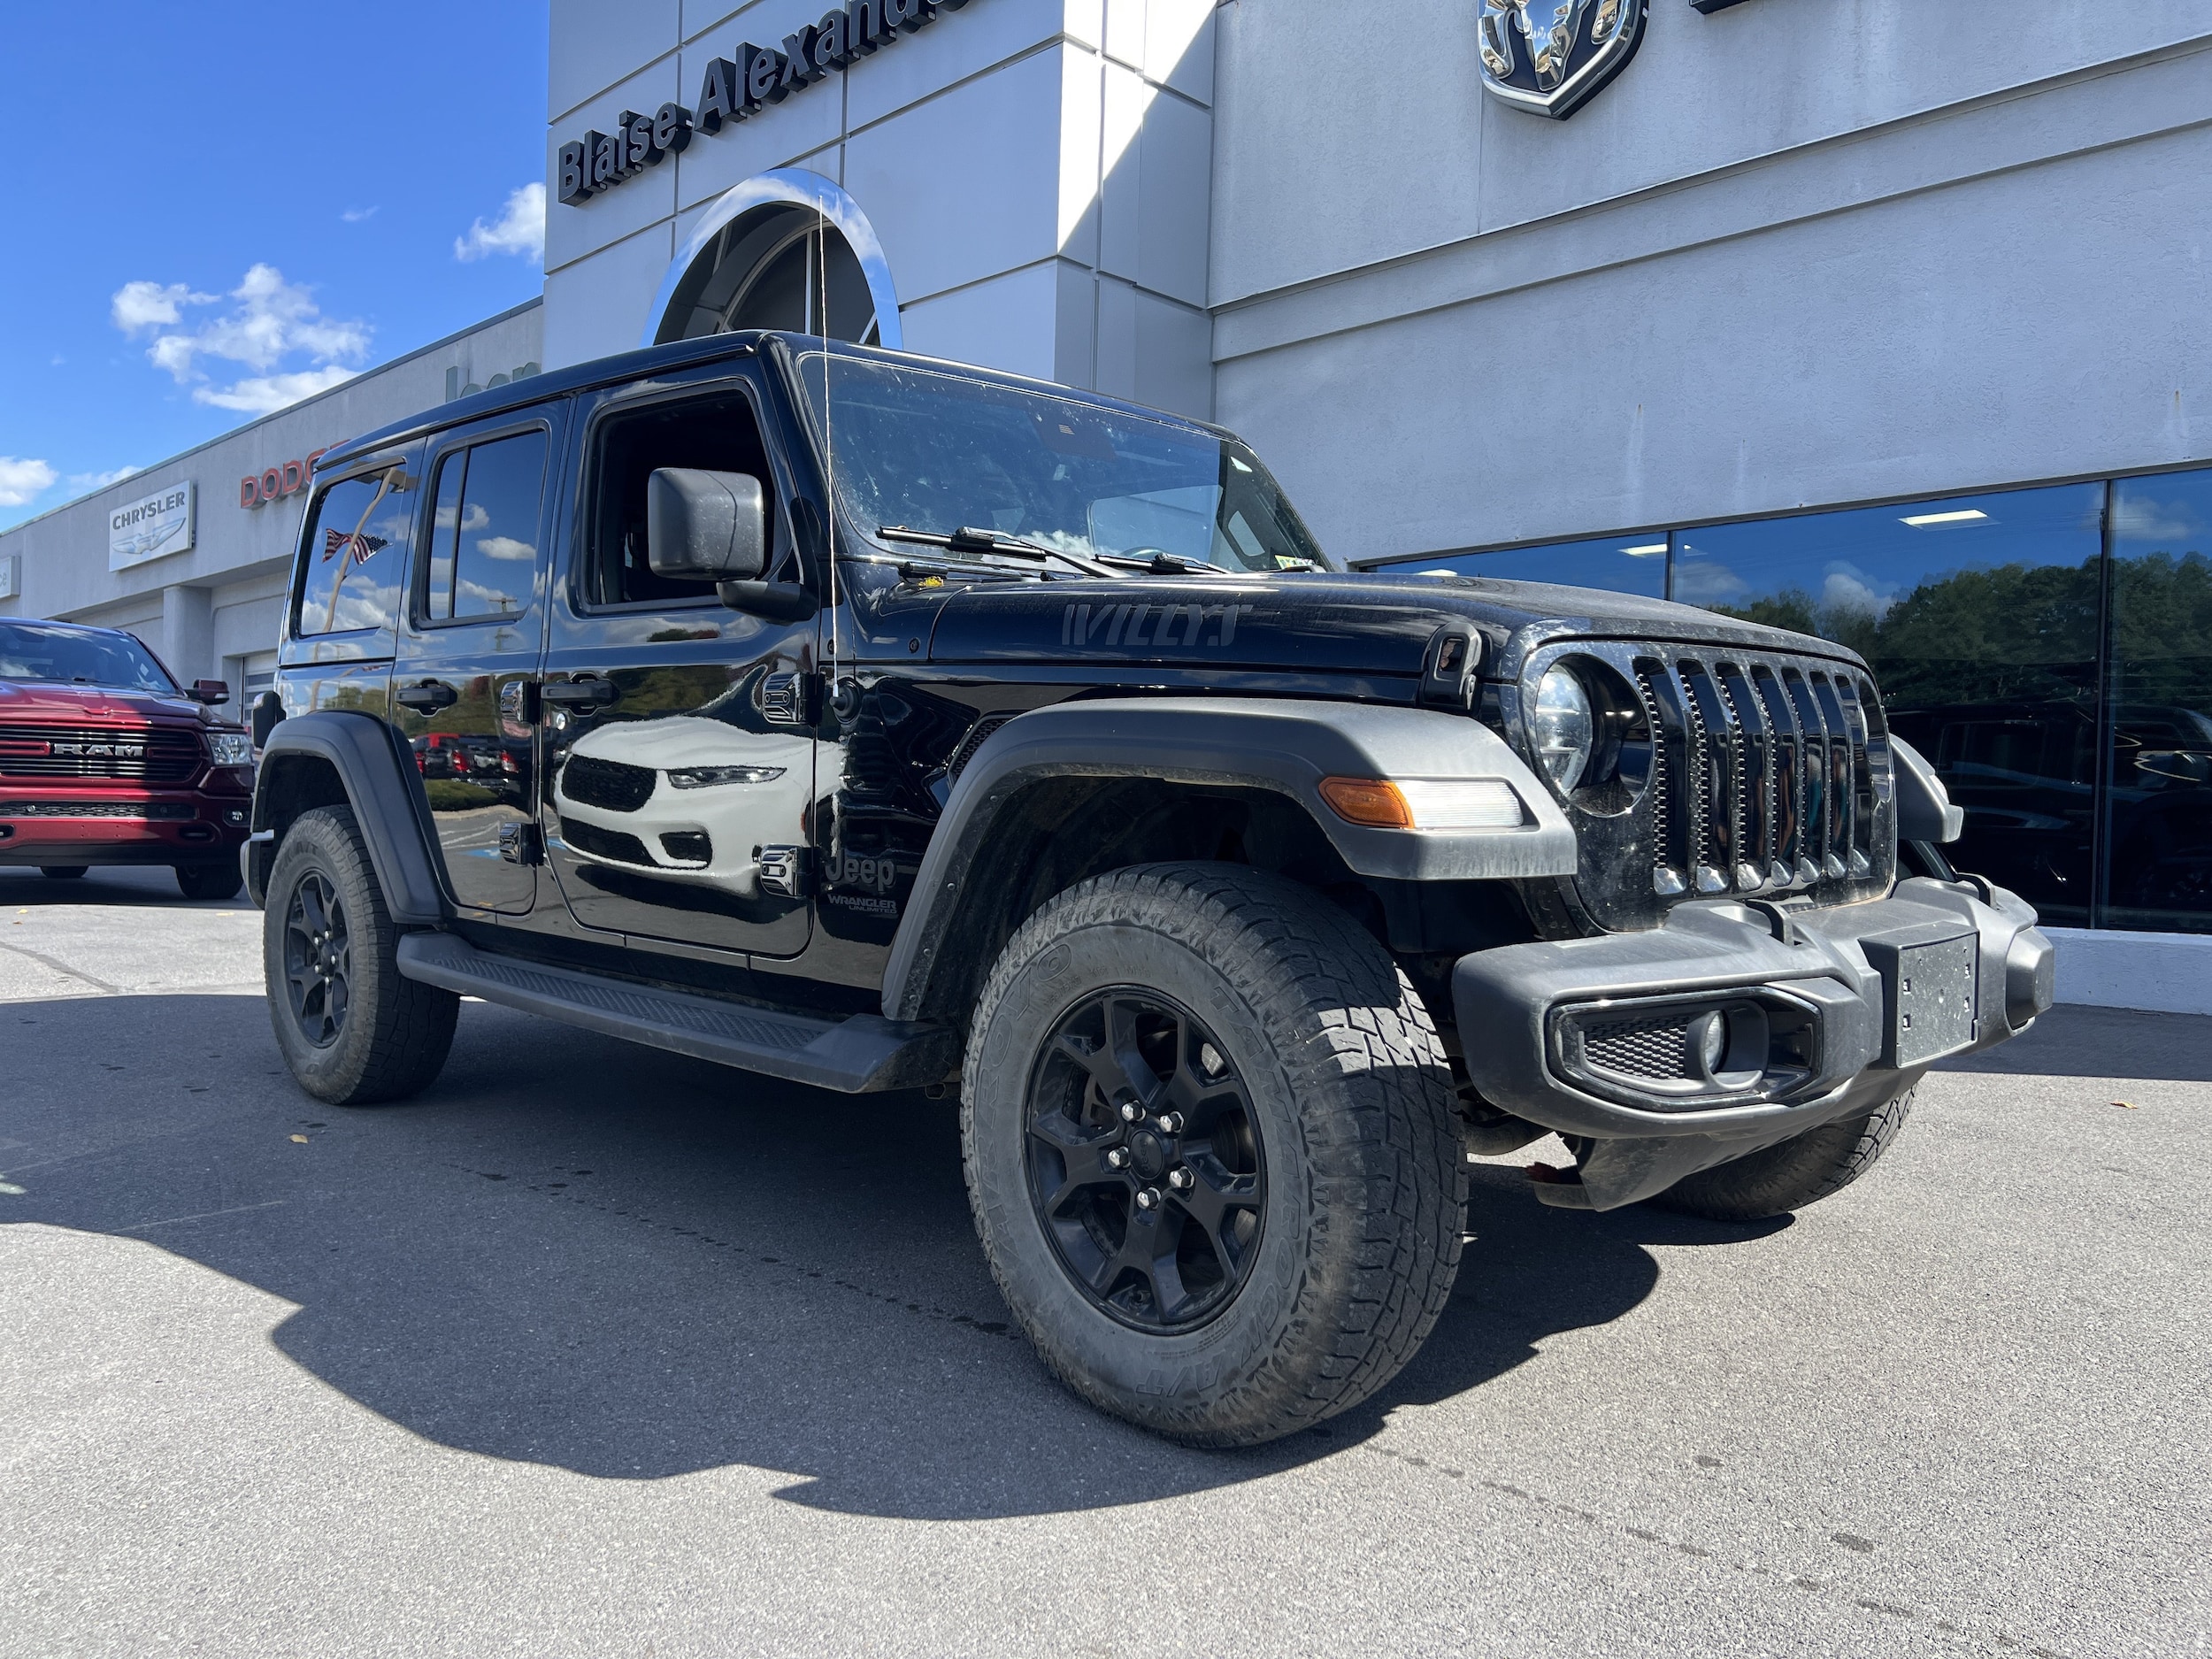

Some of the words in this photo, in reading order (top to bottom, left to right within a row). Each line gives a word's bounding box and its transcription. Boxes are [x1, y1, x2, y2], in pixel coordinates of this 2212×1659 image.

[558, 102, 692, 207] Blaise
[112, 491, 185, 530] CHRYSLER
[1062, 603, 1254, 647] WILLYS
[54, 743, 143, 757] RAM
[825, 847, 896, 892] Jeep
[827, 893, 896, 910] WRANGLER
[849, 904, 897, 914] UNLIMITED
